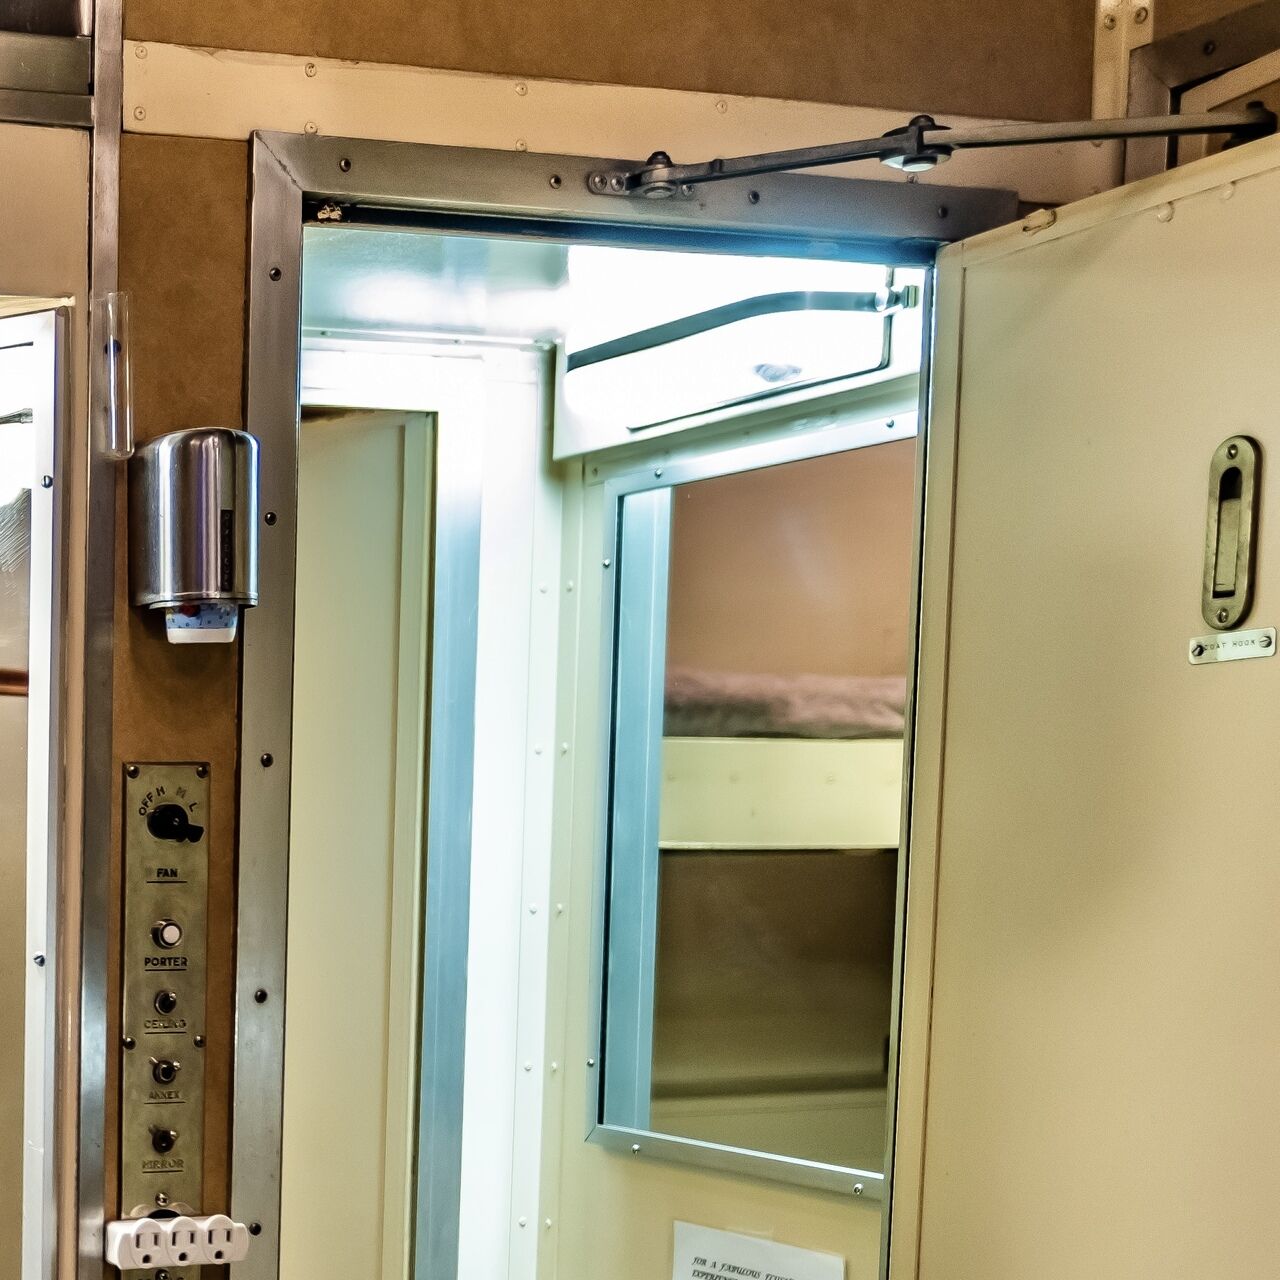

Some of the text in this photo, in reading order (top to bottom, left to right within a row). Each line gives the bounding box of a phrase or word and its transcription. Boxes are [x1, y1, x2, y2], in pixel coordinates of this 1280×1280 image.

[1232, 640, 1256, 648] HOOK
[139, 792, 154, 816] OFF
[188, 802, 197, 812] L
[157, 868, 178, 878] FAN
[144, 957, 188, 967] PORTER
[692, 1257, 707, 1266] FOR
[710, 1261, 717, 1269] A
[720, 1263, 761, 1279] FABULOUS
